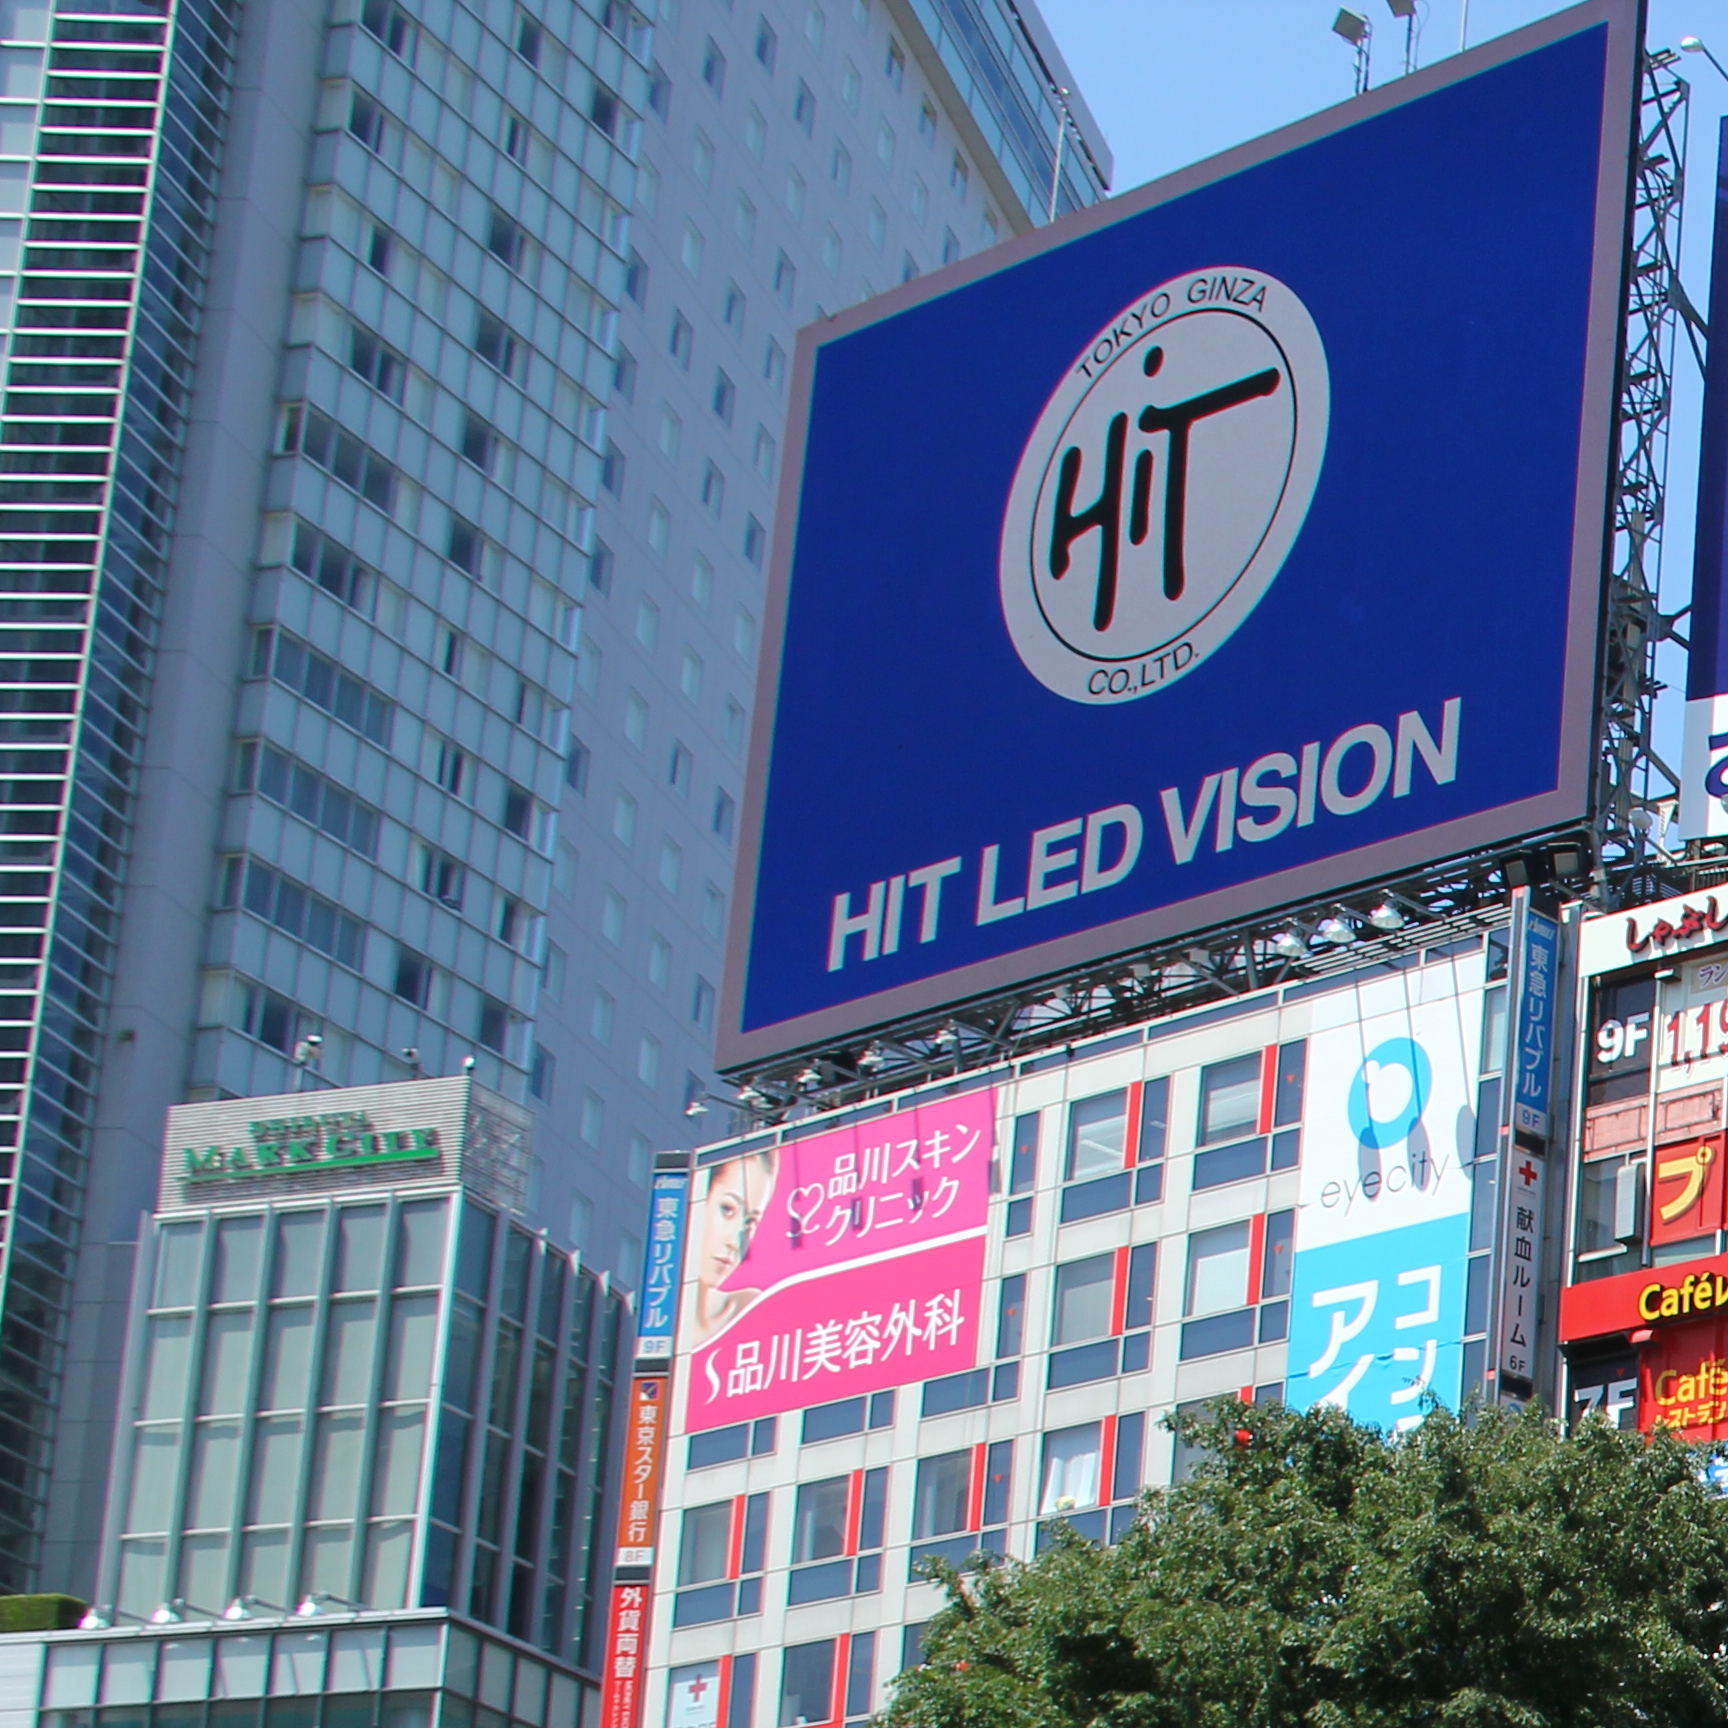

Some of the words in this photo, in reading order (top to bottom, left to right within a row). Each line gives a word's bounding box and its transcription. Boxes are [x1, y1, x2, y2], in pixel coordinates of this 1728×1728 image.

[1077, 292, 1172, 381] TOKYO
[1186, 275, 1267, 312] GINZA
[827, 857, 961, 973] HIT
[976, 804, 1143, 926] LED
[1161, 697, 1462, 866] VISION
[1522, 942, 1549, 1098] 東急リバブル
[1596, 1011, 1650, 1064] 9F
[183, 1140, 316, 1172] MARK
[326, 1129, 434, 1157] CITY
[831, 1123, 981, 1194] 品川スキン
[1320, 1152, 1448, 1213] eyecity
[823, 1177, 961, 1247] クリニック
[645, 1196, 679, 1329] 東急リバブル
[1510, 1207, 1535, 1348] 献血ルーム
[727, 1288, 965, 1397] 品川美容外科
[1509, 1355, 1526, 1372] 6F
[627, 1405, 658, 1543] 東京スター銀行
[614, 1586, 643, 1678] 外貨両替
